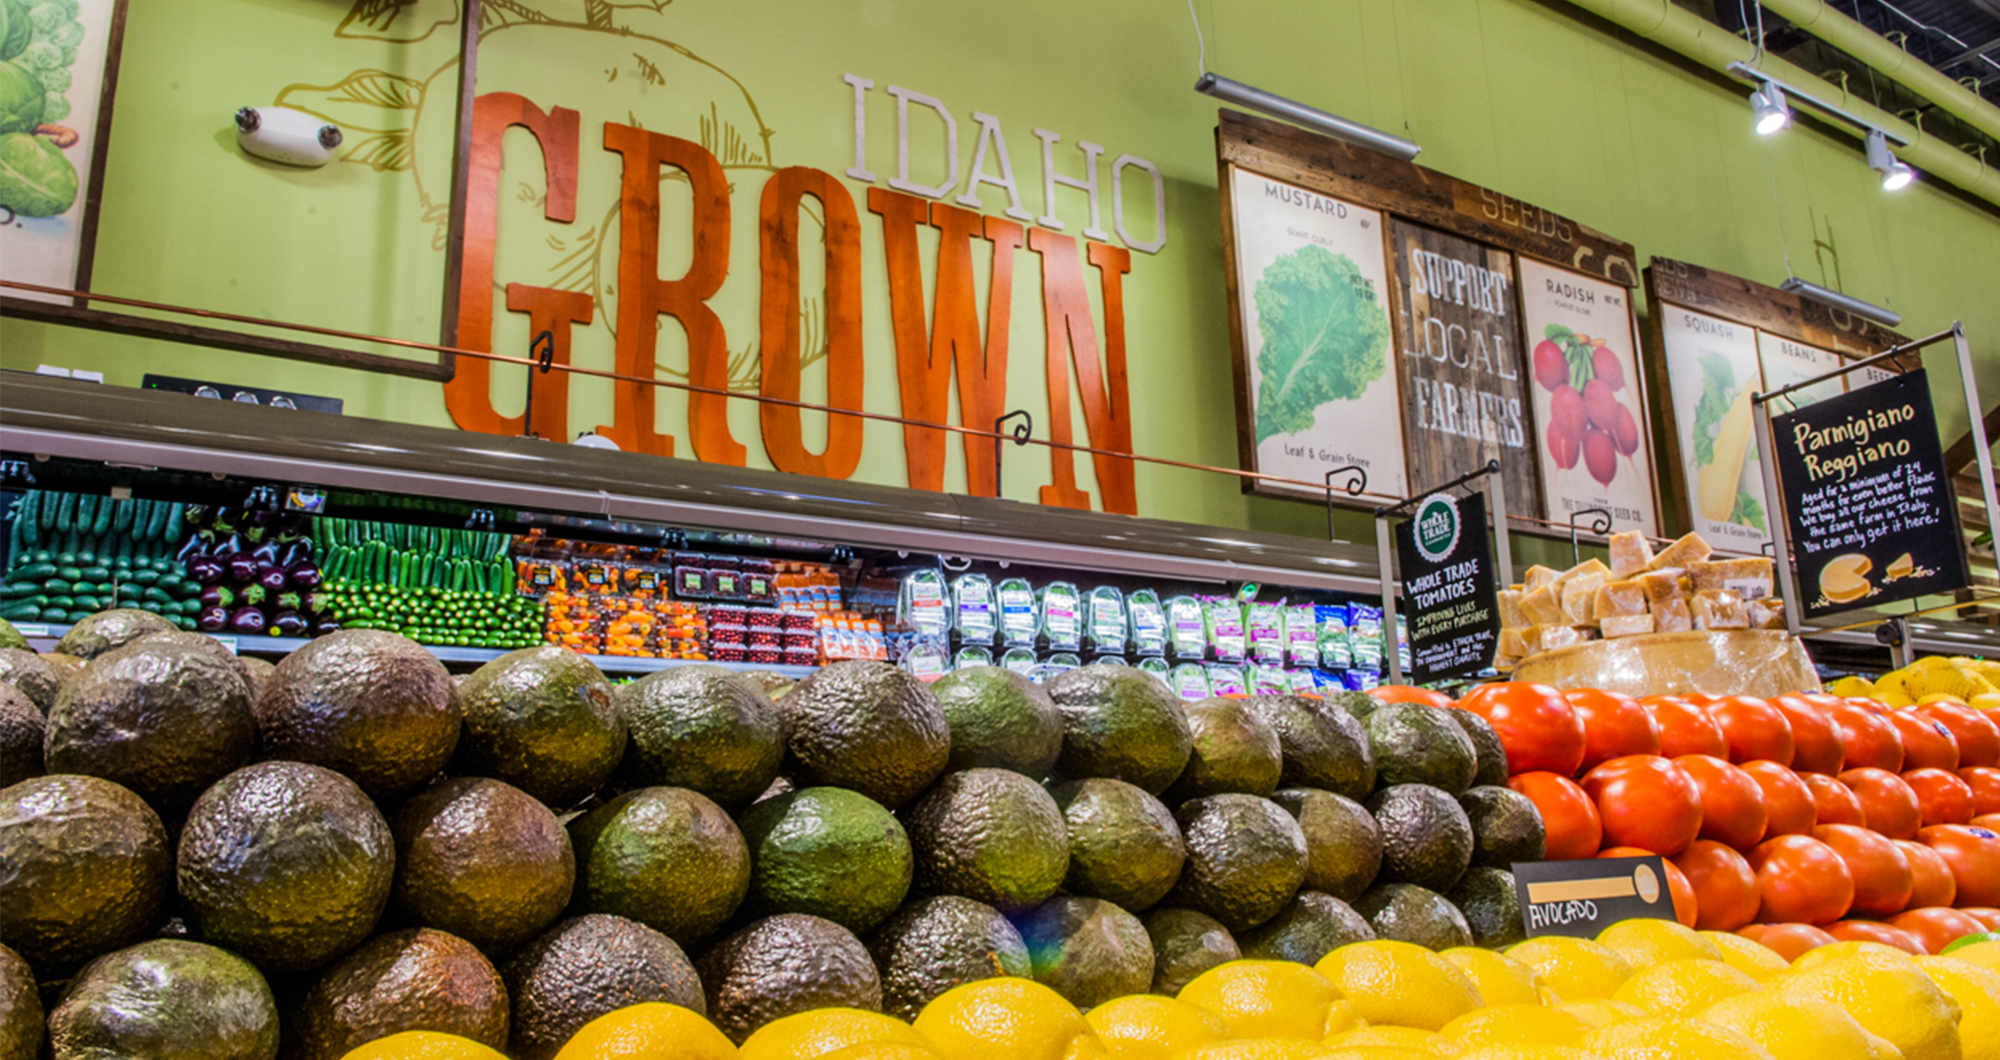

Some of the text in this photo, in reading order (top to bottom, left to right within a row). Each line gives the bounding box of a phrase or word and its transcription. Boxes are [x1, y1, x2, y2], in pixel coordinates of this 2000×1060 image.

[844, 74, 1166, 254] IDAHO
[1264, 181, 1348, 219] MUSTARD
[1480, 187, 1573, 243] SEEDS
[1412, 248, 1507, 316] SUPPORT
[1546, 278, 1595, 304] RADISH
[444, 91, 1138, 516] GROWN
[1684, 314, 1734, 340] SQUASH
[1400, 310, 1517, 381] LOCAL
[1781, 341, 1817, 363] BEANS
[1413, 376, 1524, 448] FARMERS
[1793, 404, 1915, 455] Parmigiano
[1284, 443, 1304, 457] Leaf
[1318, 449, 1345, 463] Grain
[1346, 454, 1370, 468] Store
[1803, 439, 1911, 483] Reggiano
[1801, 461, 1921, 506] Aged for a minimum of 24
[1802, 499, 1835, 515] months
[1838, 493, 1850, 507] for
[1851, 490, 1874, 502] even
[1874, 481, 1904, 496] better
[1421, 511, 1450, 530] WHOLE
[1800, 515, 1818, 527] We
[1818, 511, 1836, 524] buy
[1838, 505, 1850, 517] all
[1851, 502, 1866, 513] our
[1868, 493, 1906, 509] cheese
[1810, 525, 1827, 537] the
[1829, 520, 1855, 534] same
[1886, 508, 1896, 519] in
[1896, 499, 1930, 515] Italy.
[1423, 522, 1451, 540] TRADE
[1708, 522, 1721, 533] Leaf
[1729, 525, 1746, 537] Grain
[1747, 529, 1762, 539] Store
[1803, 507, 1940, 554] You can only get it here!
[1406, 558, 1480, 595] WHOLE TRADE
[1413, 577, 1476, 610] TOMATOES
[1411, 608, 1489, 641] WITH EVERY PURCHASE
[1415, 600, 1477, 628] IMPROVING LIVES
[1528, 900, 1598, 929] AVOCADO
